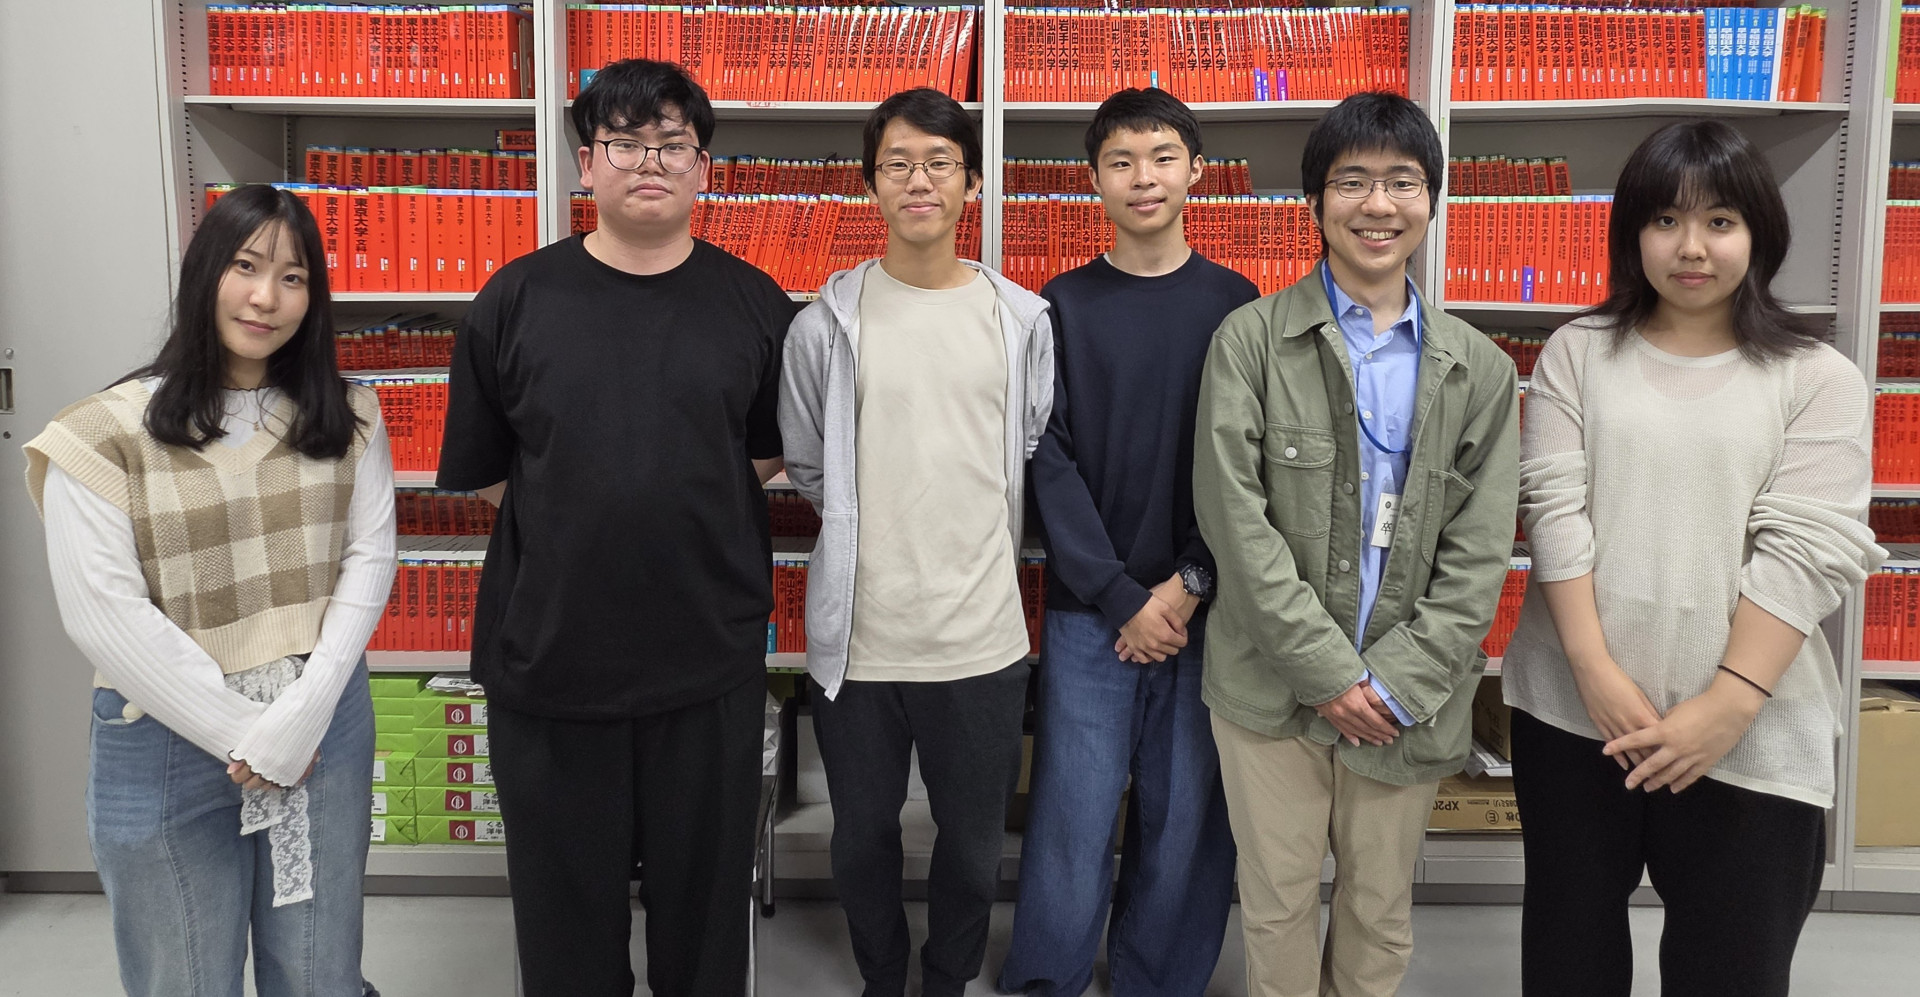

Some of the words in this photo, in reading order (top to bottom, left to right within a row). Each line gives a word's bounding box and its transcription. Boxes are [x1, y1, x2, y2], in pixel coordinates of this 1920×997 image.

[370, 17, 381, 53] 東北大学
[407, 17, 418, 54] 東北大学
[682, 17, 691, 68] 東京学芸大学
[694, 17, 702, 68] 東京学芸大学
[779, 17, 790, 68] 東京農工大学
[1047, 19, 1055, 70] 弘前大学
[1058, 19, 1068, 70] 岩手大学
[1112, 20, 1120, 71] 山形大学
[1140, 19, 1148, 58] 茨城大学
[1186, 20, 1197, 71] 群馬大学
[1200, 20, 1212, 71] 群馬大学
[1214, 20, 1226, 71] 群馬大学
[1399, 18, 1408, 54] 富山大学
[1459, 16, 1470, 47] 早稲田大学
[1475, 15, 1484, 46] 早稲田大学
[1486, 16, 1498, 53] 早稲田大学
[1505, 16, 1516, 53] 早稲田大学
[1520, 16, 1530, 46] 早稲田大学
[1536, 16, 1548, 53] 早稲田大学
[1550, 16, 1560, 53] 早稲田大学
[1564, 16, 1575, 53] 早稲田大学
[1579, 16, 1589, 47] 早稲田大学
[1607, 17, 1616, 50] 早稲田大学
[1625, 18, 1637, 54] 早稲田大学
[1639, 18, 1648, 48] 早稲田大学
[1652, 18, 1661, 48] 早稲田大学
[1666, 19, 1676, 55] 早稲田大学
[1680, 19, 1691, 55] 早稲田大学
[1708, 28, 1717, 56] 早稲田大学
[1720, 28, 1733, 56] 早稲田大学
[1736, 28, 1746, 56] 早稲田大学
[1748, 28, 1760, 57] 早稲田大学
[1762, 29, 1774, 57] 早稲田大学
[714, 168, 725, 194] 一橋大
[735, 168, 747, 194] 一橋大
[754, 168, 766, 194] 一橋大
[1462, 166, 1472, 195] 早稲田大
[1478, 165, 1490, 194] 早稲田大
[1516, 166, 1528, 196] 早稲田大
[1534, 166, 1546, 196] 早稲田大
[326, 197, 337, 236] 東京大学
[354, 198, 368, 237] 東京大学
[1286, 207, 1295, 260] 京都府立大学
[1501, 205, 1509, 242] 早稲田大学
[1542, 205, 1550, 242] 早稲田大学
[1584, 205, 1592, 243] 早稲田大学
[327, 239, 336, 252] 理科
[356, 240, 367, 252] 文科
